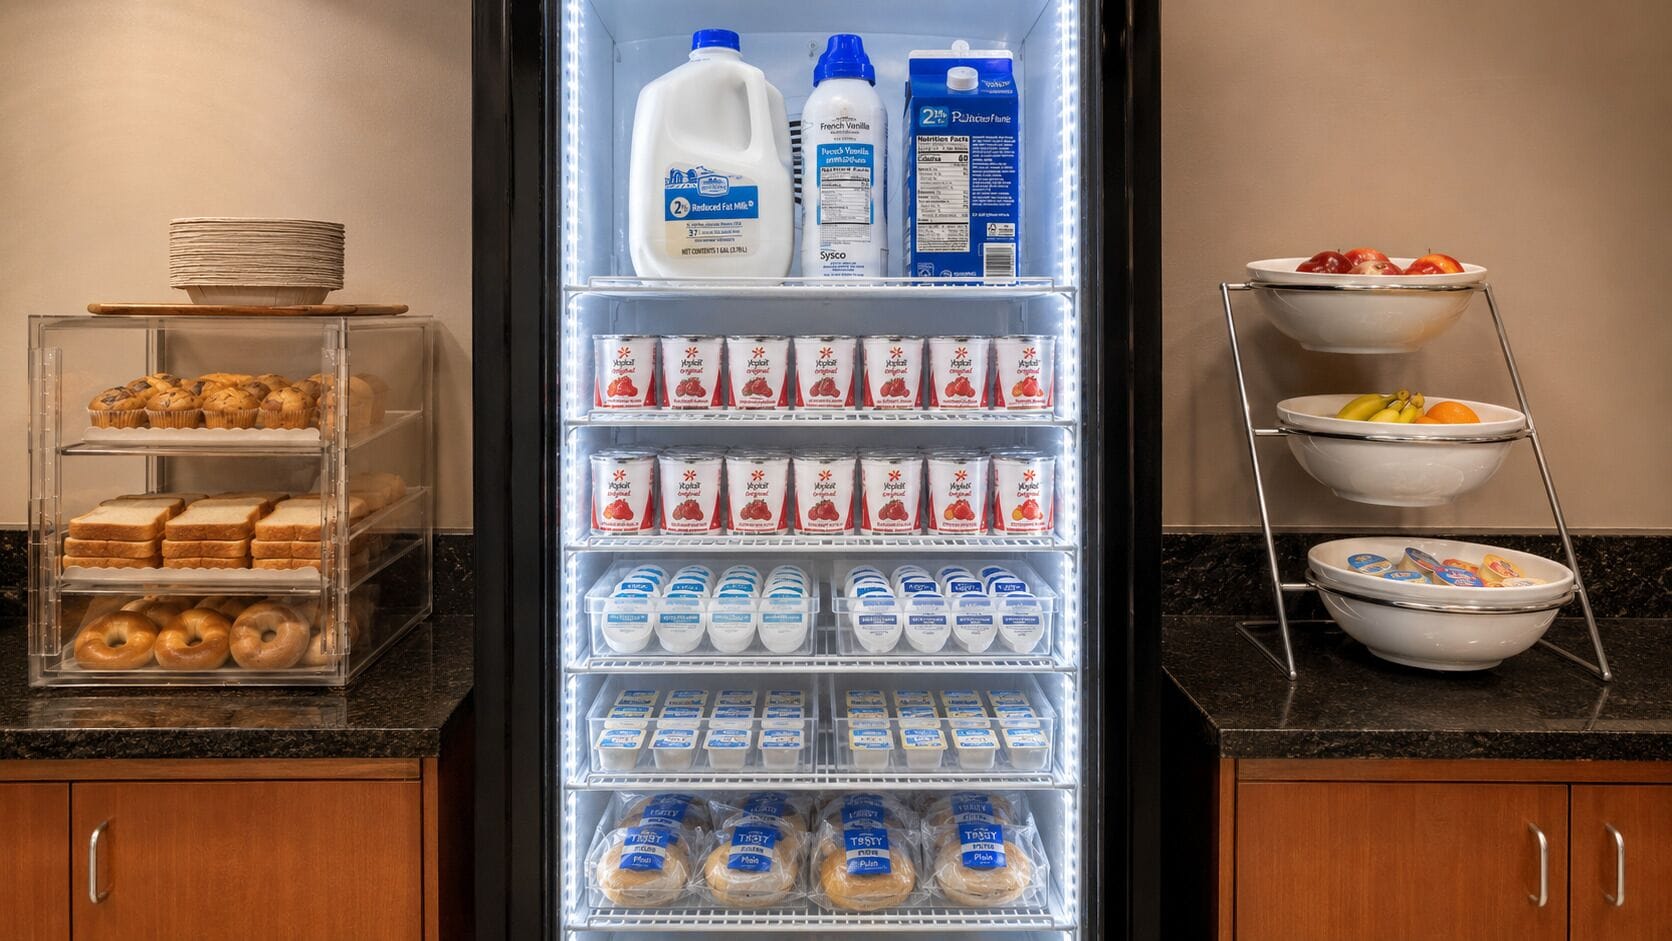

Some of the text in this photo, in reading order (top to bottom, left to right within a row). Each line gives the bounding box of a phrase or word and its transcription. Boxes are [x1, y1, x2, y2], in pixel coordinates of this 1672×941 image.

[820, 121, 870, 130] French Vanilla
[692, 203, 721, 212] Reduced
[722, 203, 733, 211] Fat
[688, 229, 698, 237] 37
[681, 248, 691, 256] NET
[691, 247, 716, 255] CONTENTS
[820, 251, 846, 261] Sysco
